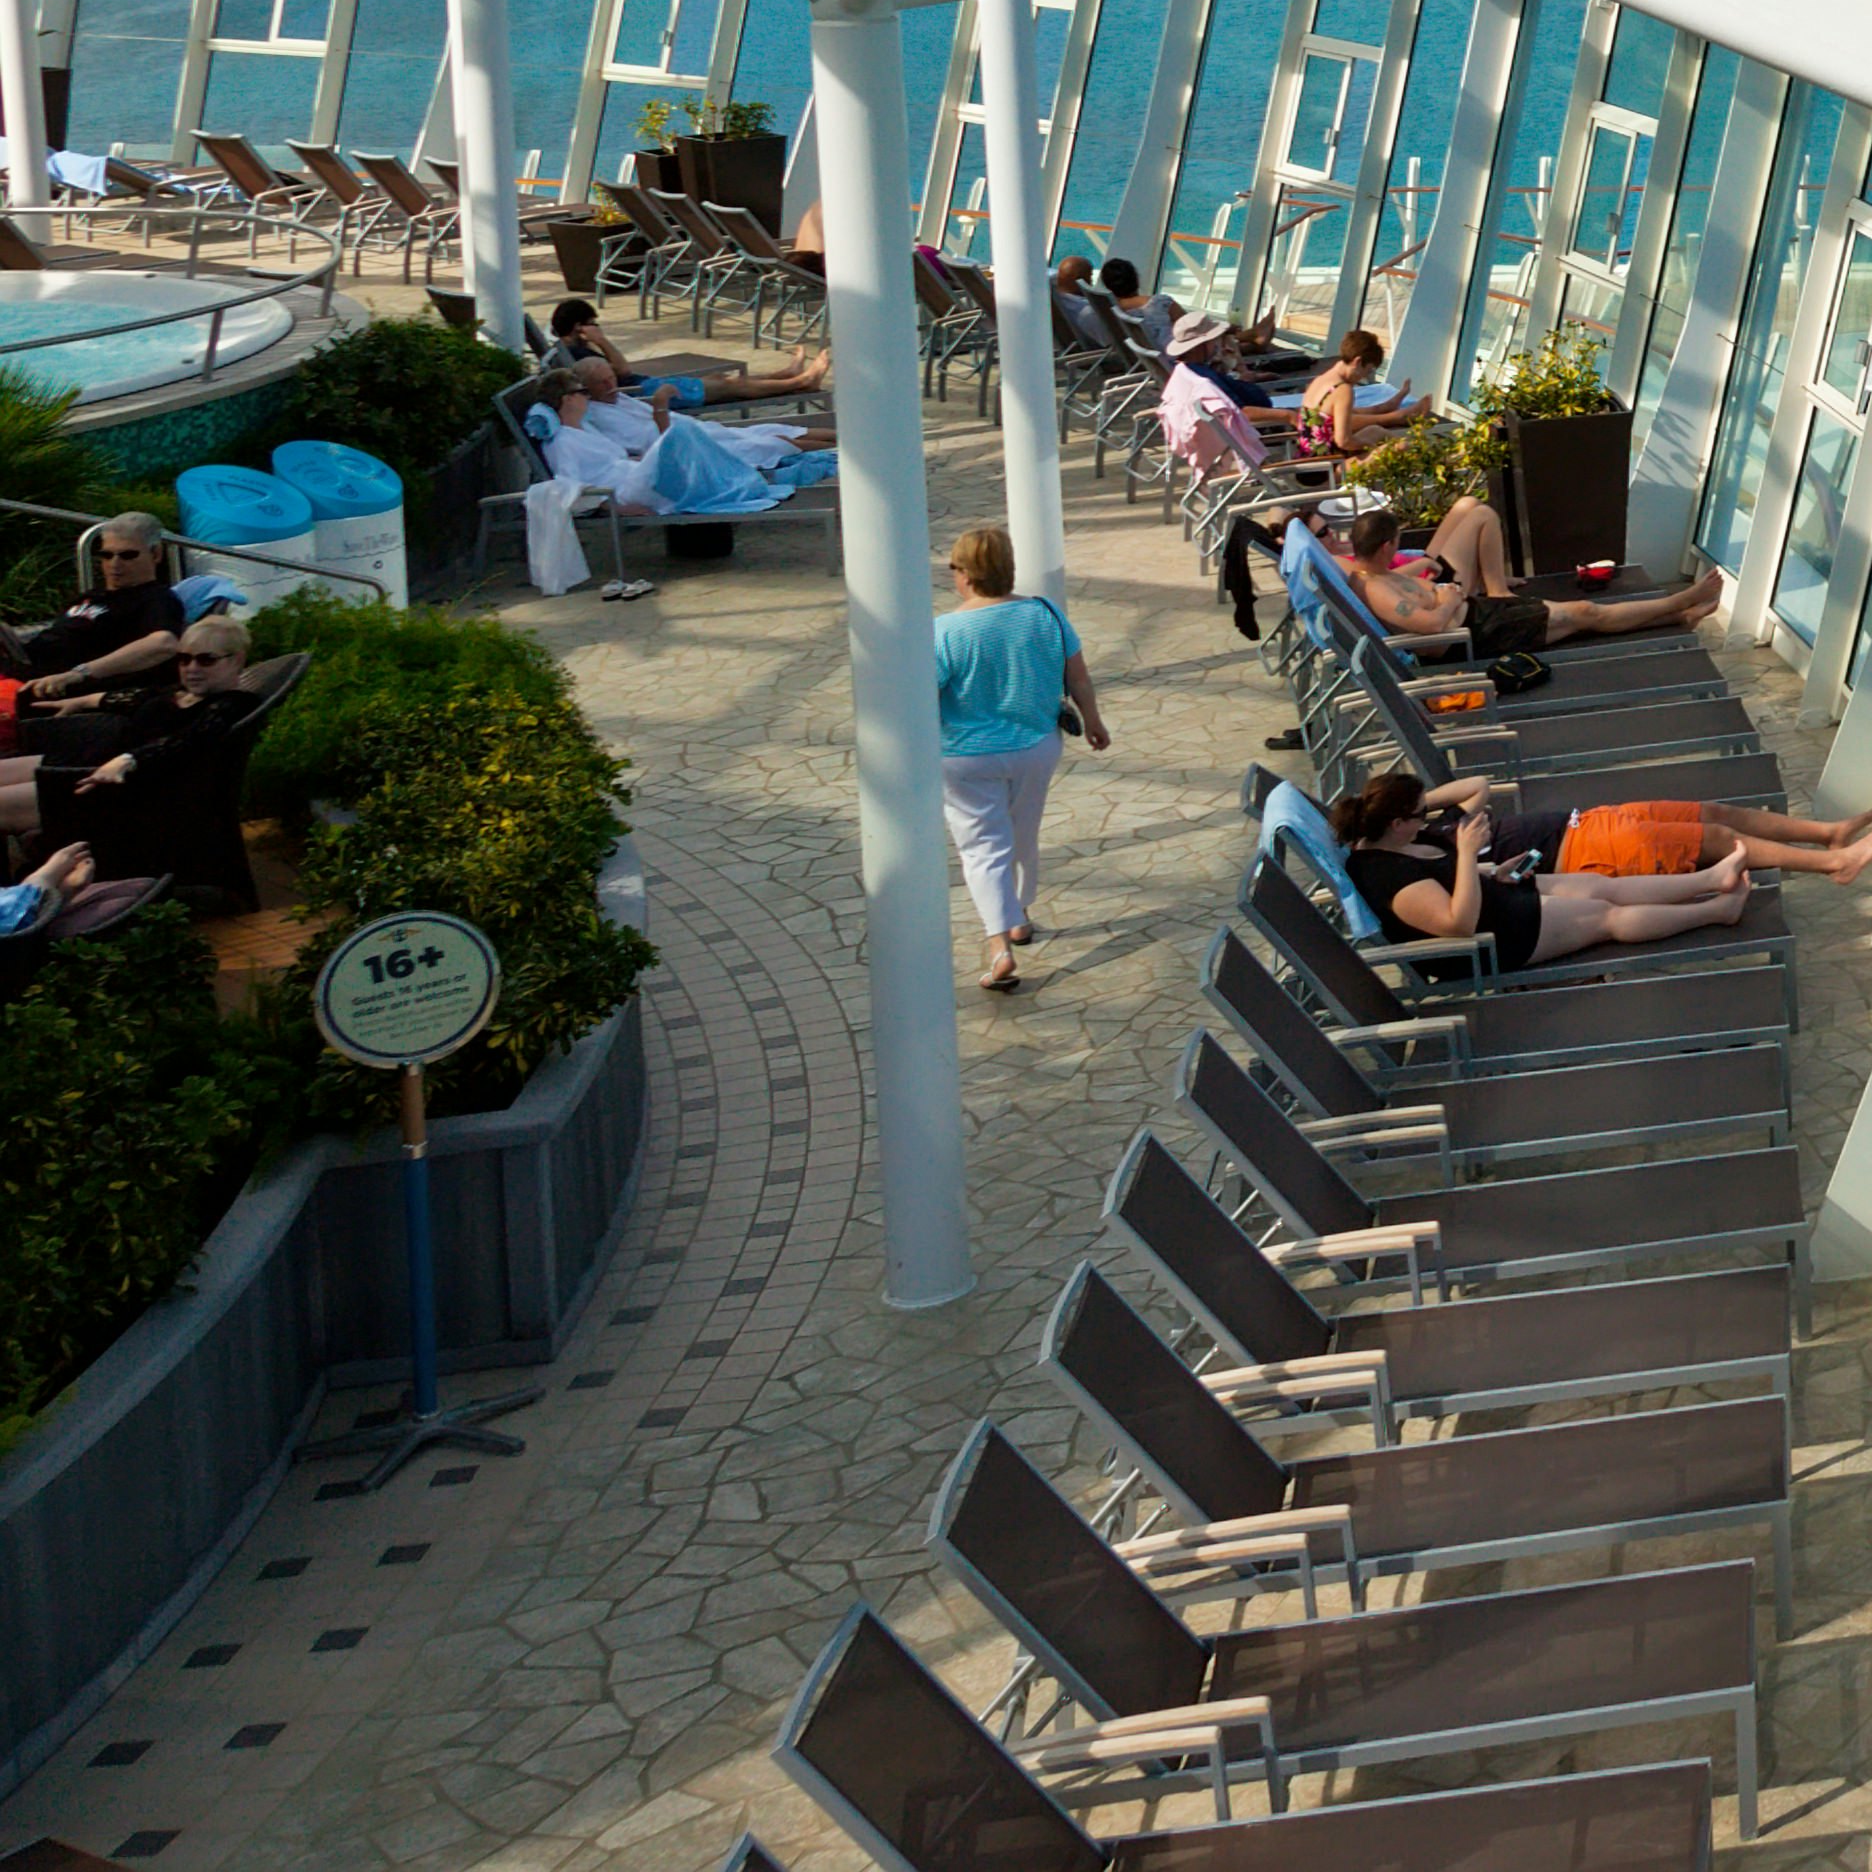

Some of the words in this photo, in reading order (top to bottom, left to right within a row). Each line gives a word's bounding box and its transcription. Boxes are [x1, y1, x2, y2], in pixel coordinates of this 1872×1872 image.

[363, 946, 445, 984] 16+
[417, 979, 450, 992] years
[455, 974, 466, 983] or
[352, 1006, 385, 1018] older
[390, 1000, 410, 1009] are
[415, 986, 470, 1003] welcome
